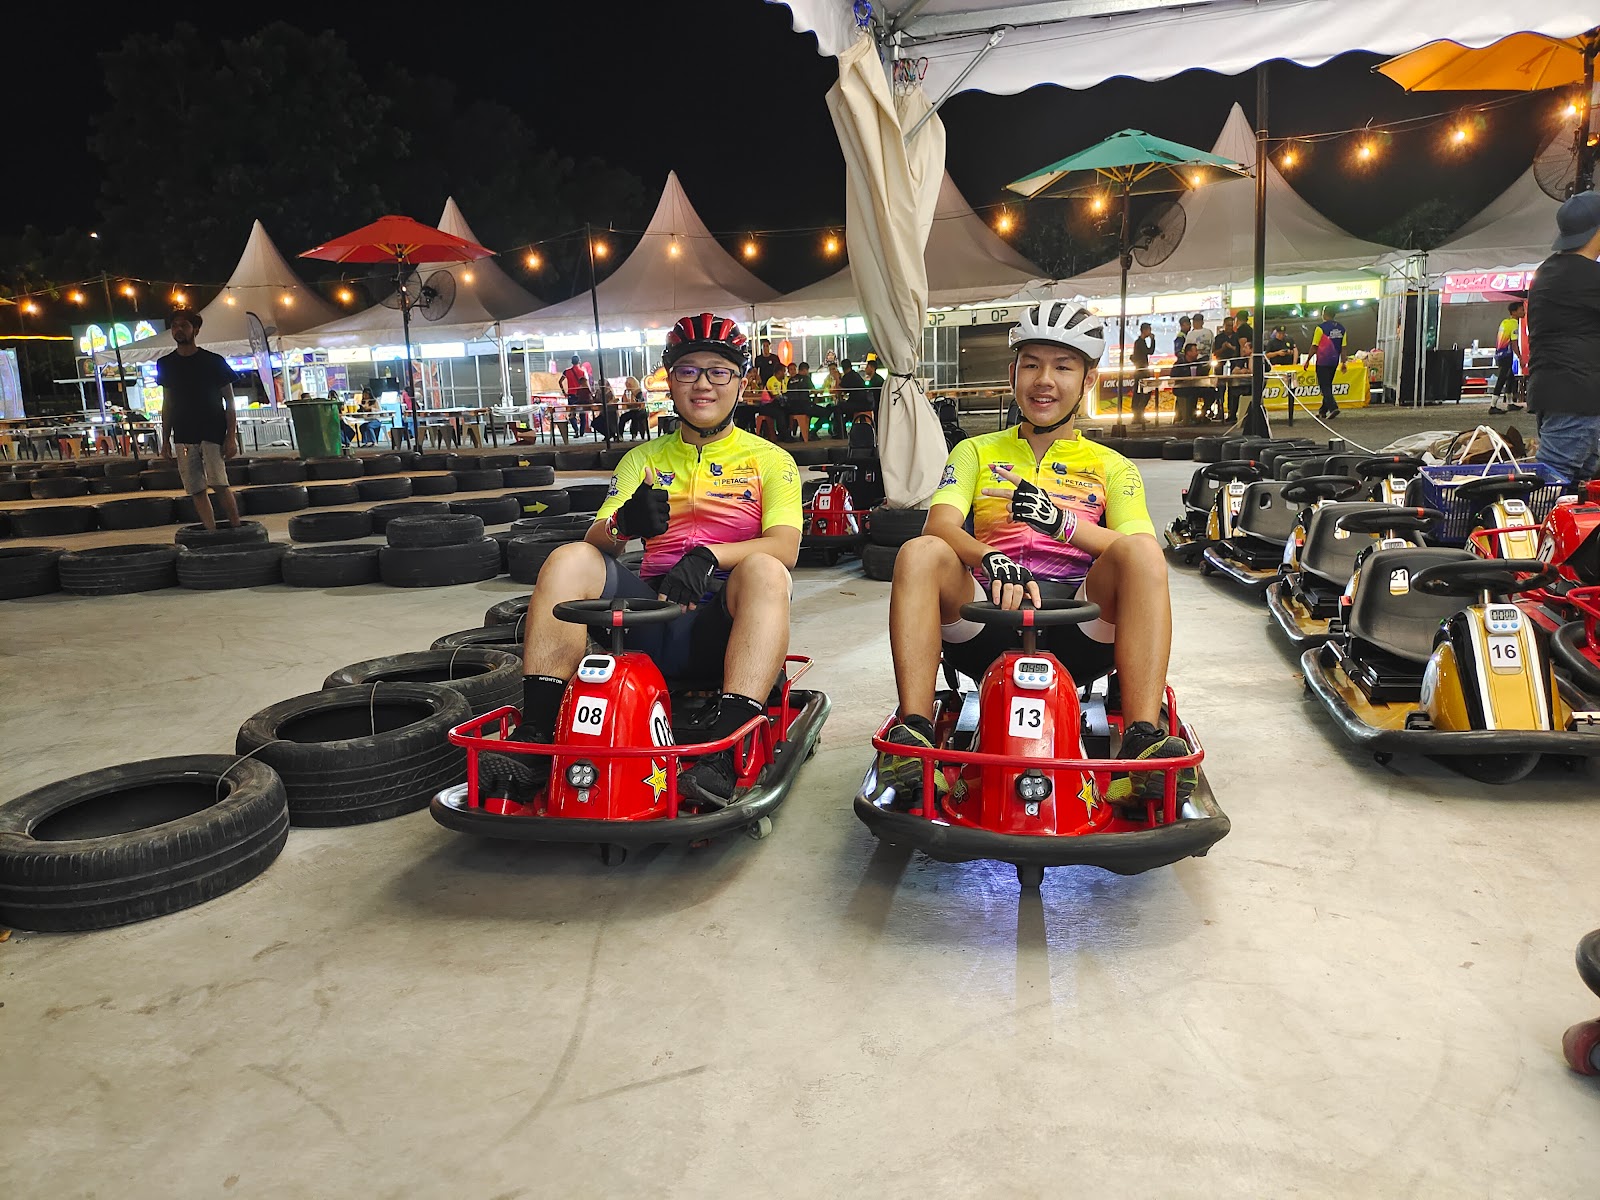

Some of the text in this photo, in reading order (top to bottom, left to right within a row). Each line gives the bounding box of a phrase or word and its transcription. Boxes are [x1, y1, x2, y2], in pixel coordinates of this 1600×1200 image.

[821, 499, 829, 507] 11
[1391, 570, 1406, 580] 21
[1492, 644, 1517, 659] 16
[577, 705, 603, 726] 08
[1014, 707, 1041, 728] 13
